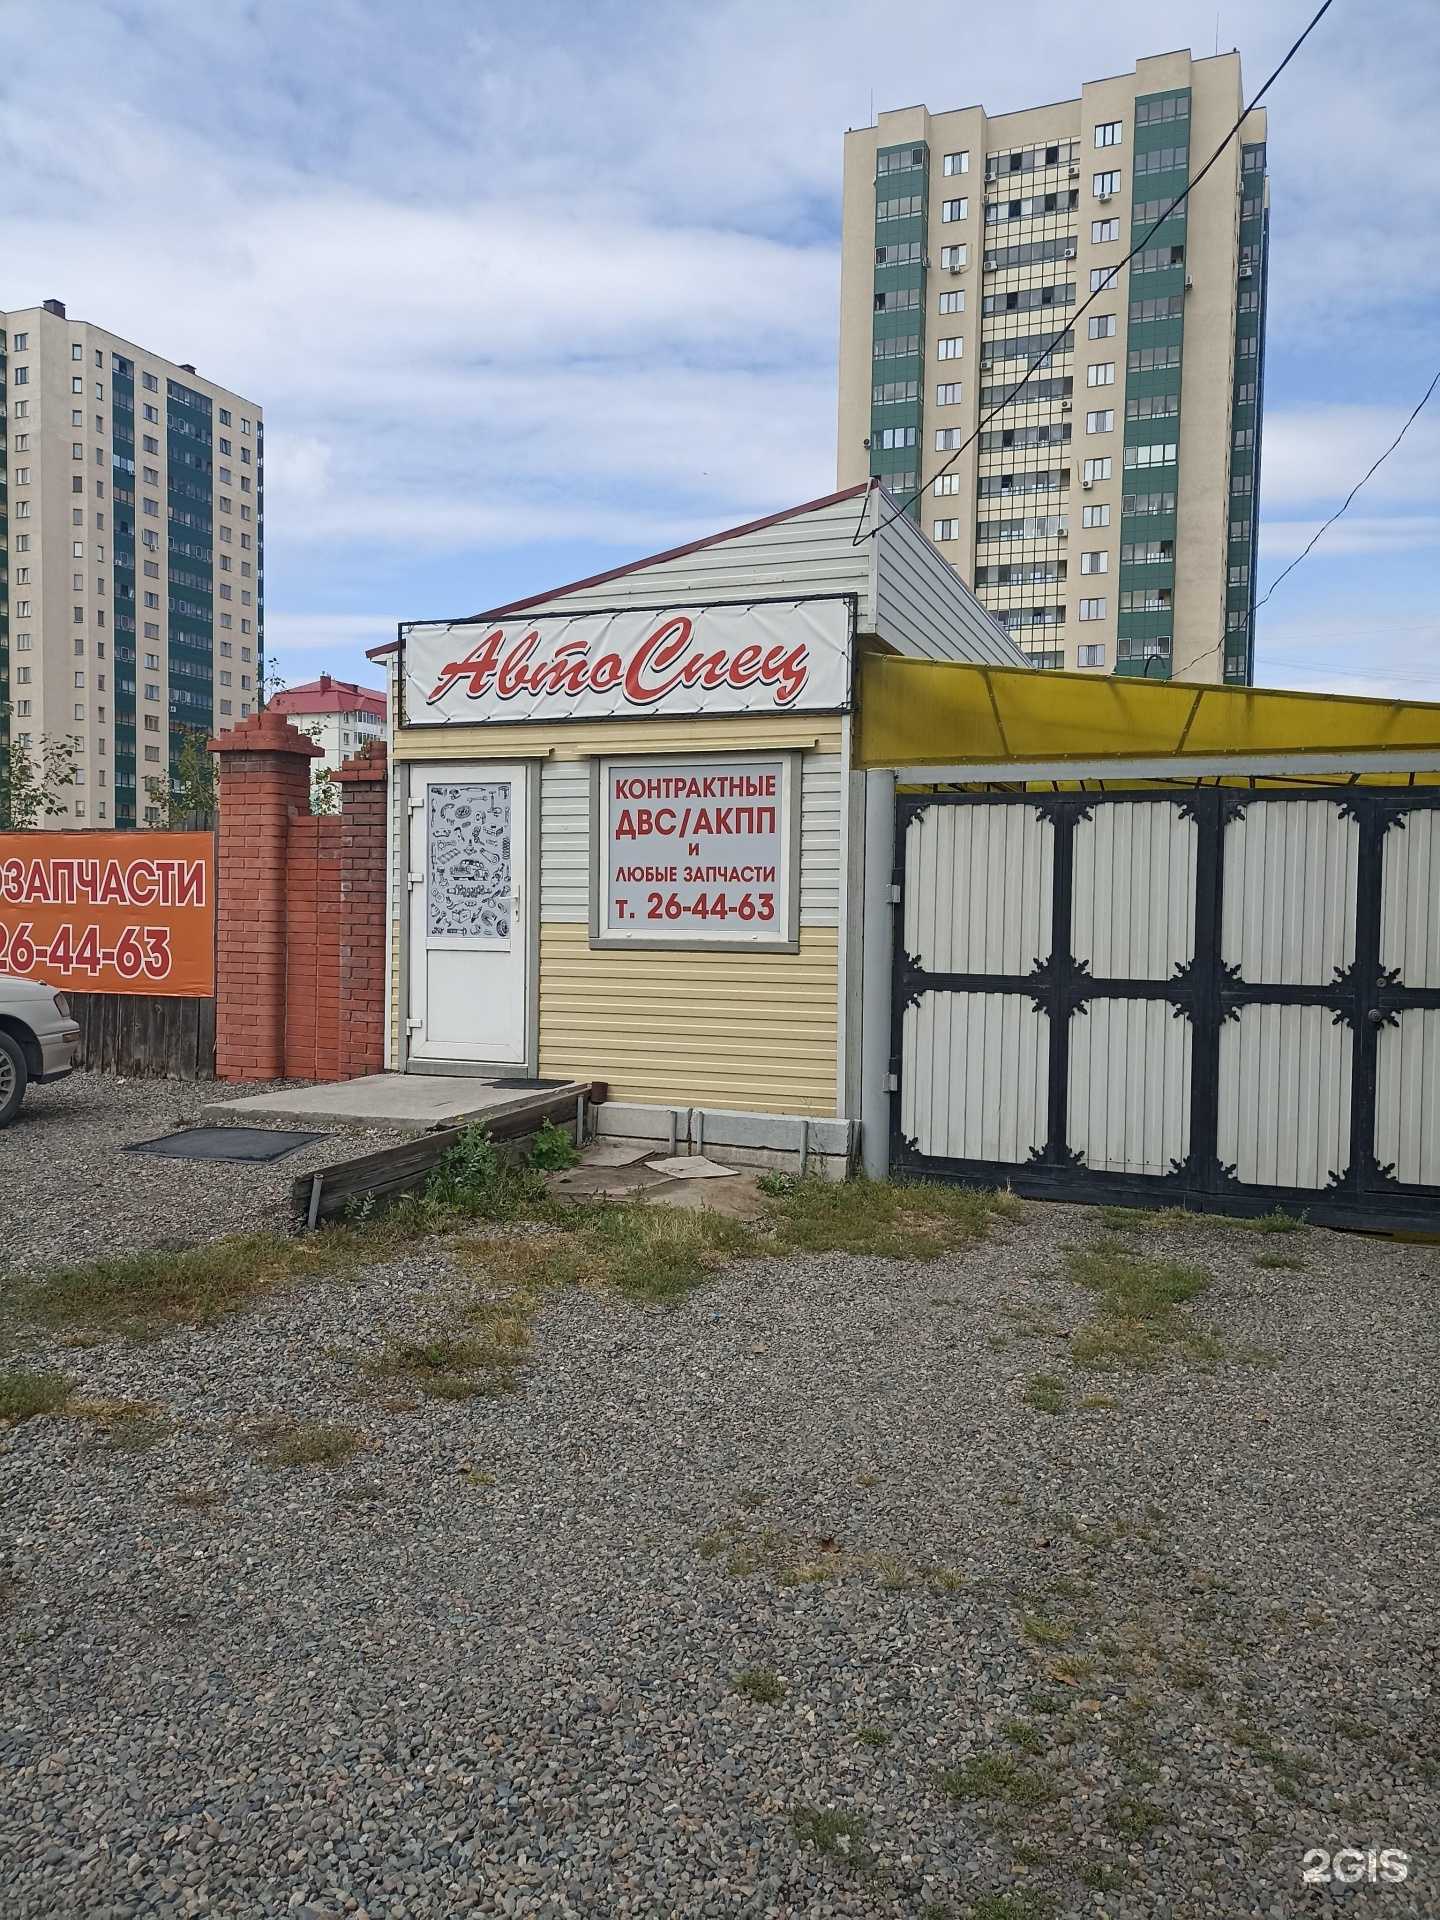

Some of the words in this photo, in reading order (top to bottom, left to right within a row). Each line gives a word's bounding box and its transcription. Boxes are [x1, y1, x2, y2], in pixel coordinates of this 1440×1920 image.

[428, 616, 810, 704] АвтоСпец
[615, 775, 776, 799] КОНТРАКТНЫЕ
[615, 806, 776, 840] ДВС/АКПП
[0, 857, 206, 907] ЗАПЧАСТИ
[615, 867, 677, 883] ЛЮБЫЕ
[684, 866, 776, 883] ЗАПЧАСТИ
[647, 892, 775, 921] 26-44-63
